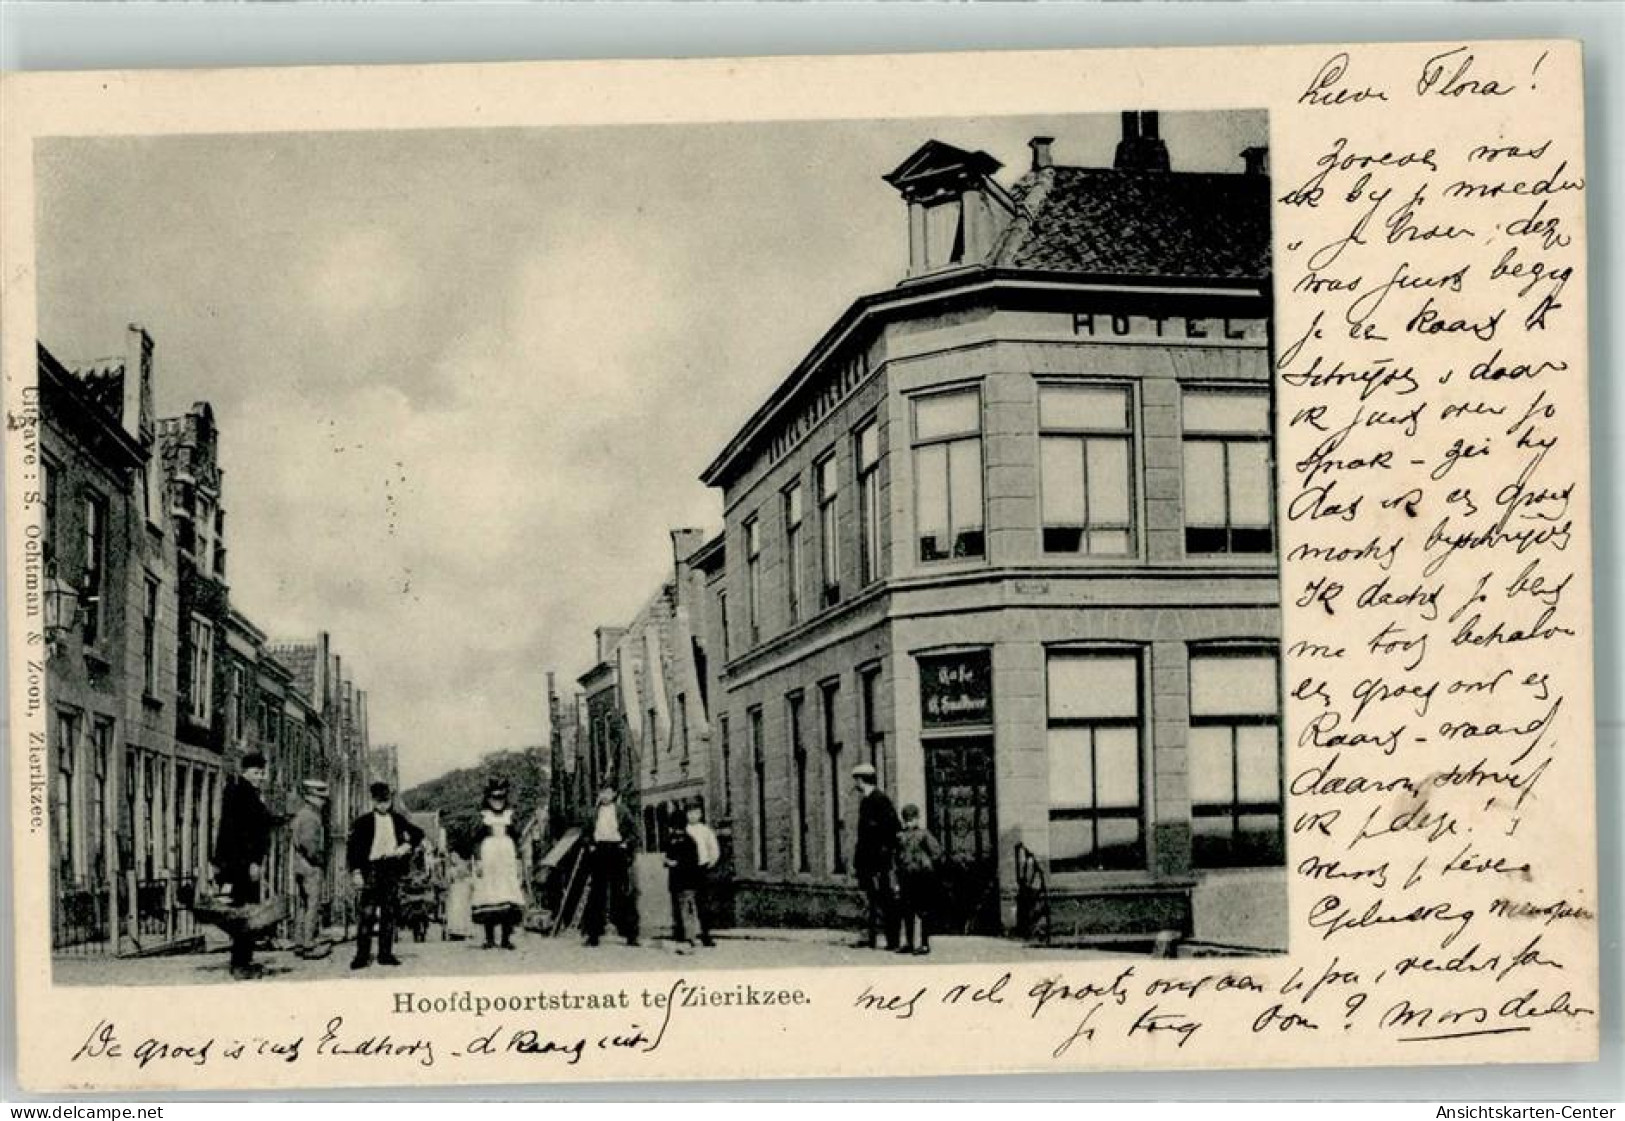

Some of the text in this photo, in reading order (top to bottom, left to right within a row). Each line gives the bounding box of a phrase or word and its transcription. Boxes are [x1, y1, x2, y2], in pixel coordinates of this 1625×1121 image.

[1072, 311, 1246, 340] HOTEL
[24, 524, 41, 618] Ochtman
[27, 631, 42, 647] &
[26, 660, 44, 719] Zoon,
[29, 732, 47, 836] Zierikzee.
[392, 985, 812, 1016] Hoofdpoortstraat te Zierikzee.
